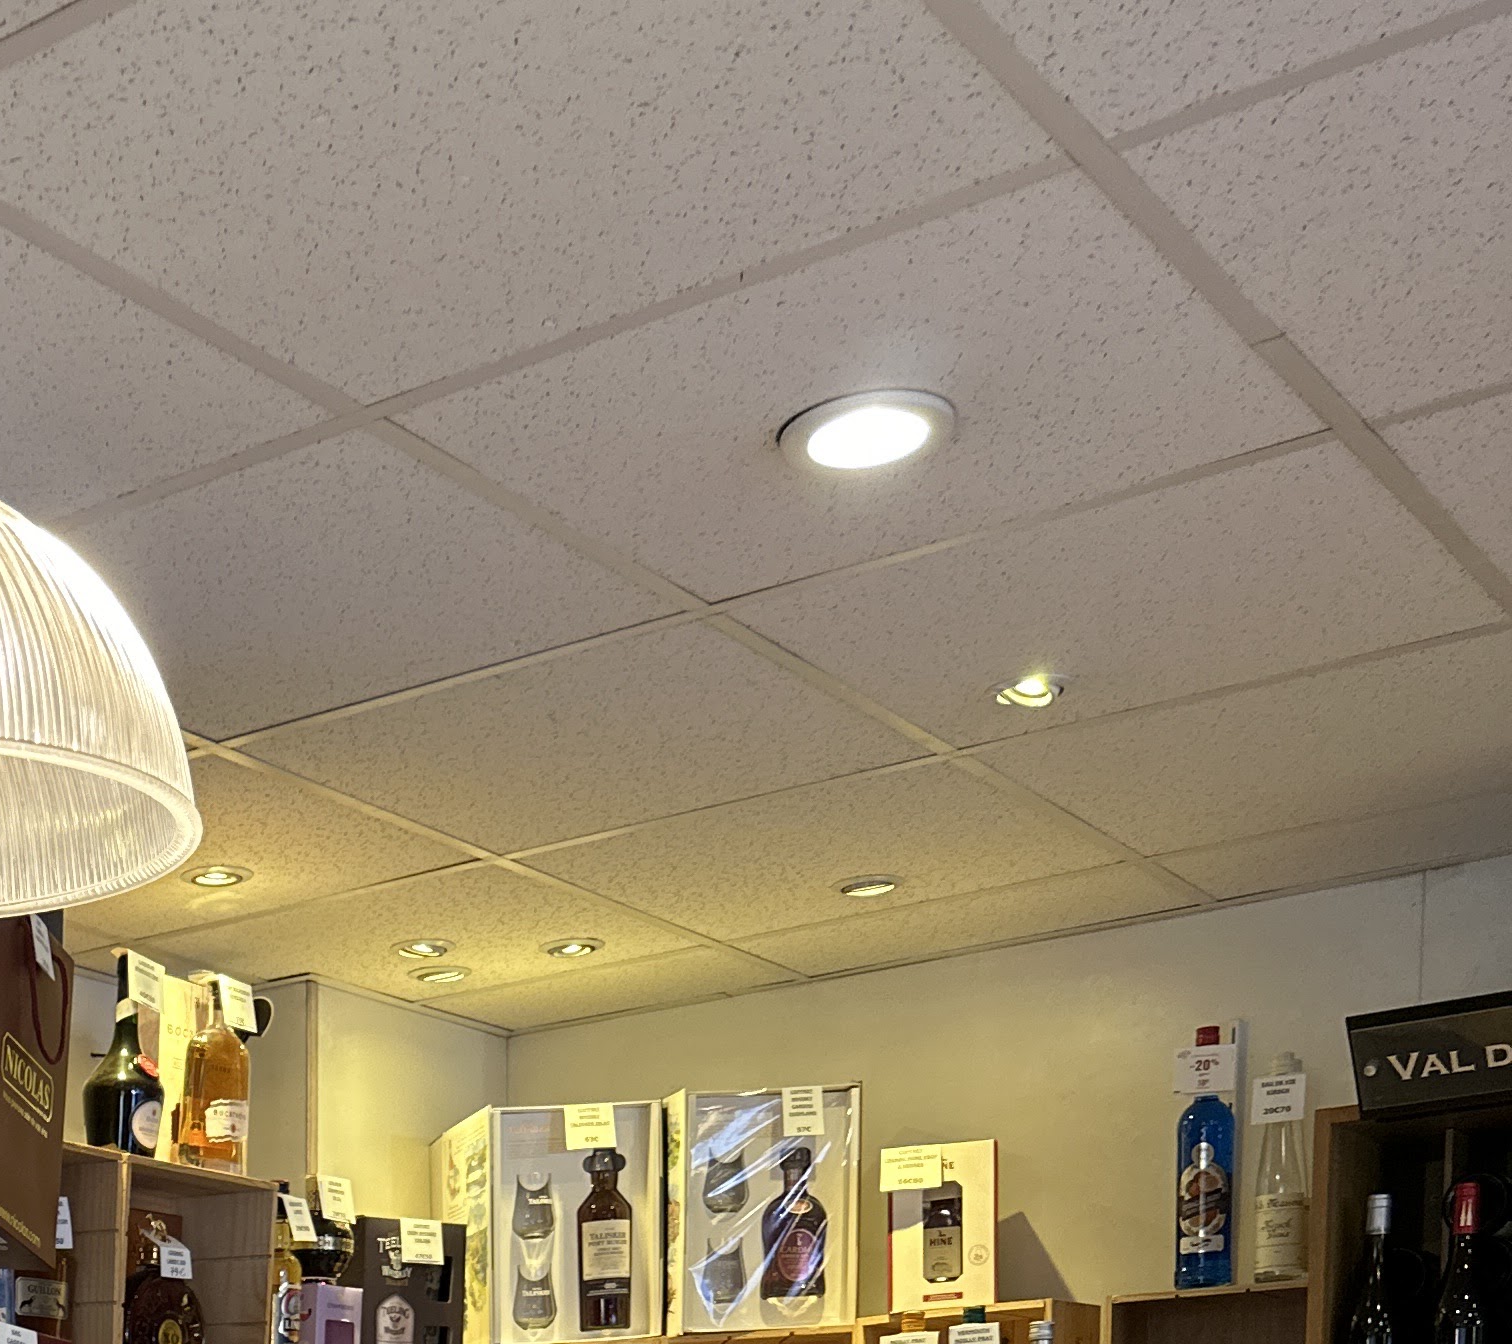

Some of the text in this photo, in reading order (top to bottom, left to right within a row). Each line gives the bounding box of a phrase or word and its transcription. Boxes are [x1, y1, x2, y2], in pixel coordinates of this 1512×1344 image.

[4, 1043, 52, 1111] NICOLAS
[1189, 1058, 1220, 1072] -20%
[1388, 1048, 1476, 1082] VAL
